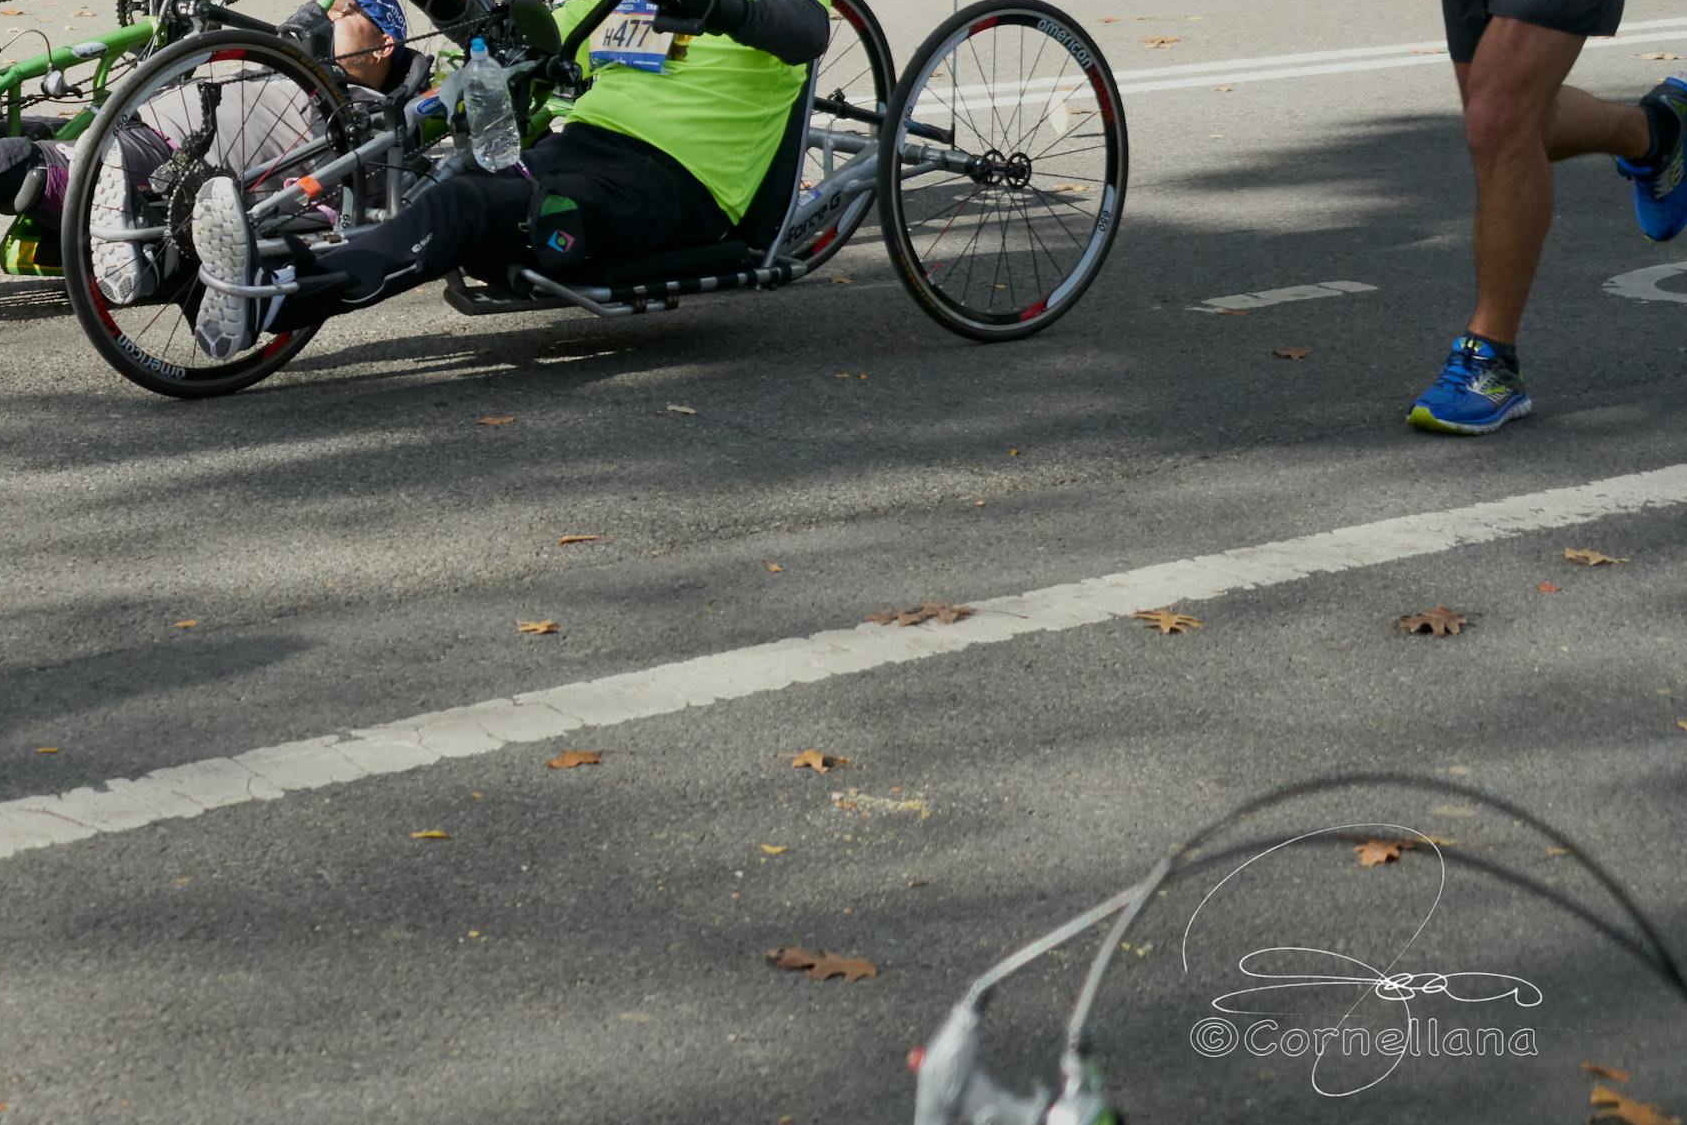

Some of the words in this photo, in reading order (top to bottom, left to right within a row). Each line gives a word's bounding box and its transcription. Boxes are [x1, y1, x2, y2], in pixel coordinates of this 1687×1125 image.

[602, 19, 654, 48] H477
[1036, 19, 1093, 70] american
[116, 333, 187, 379] american
